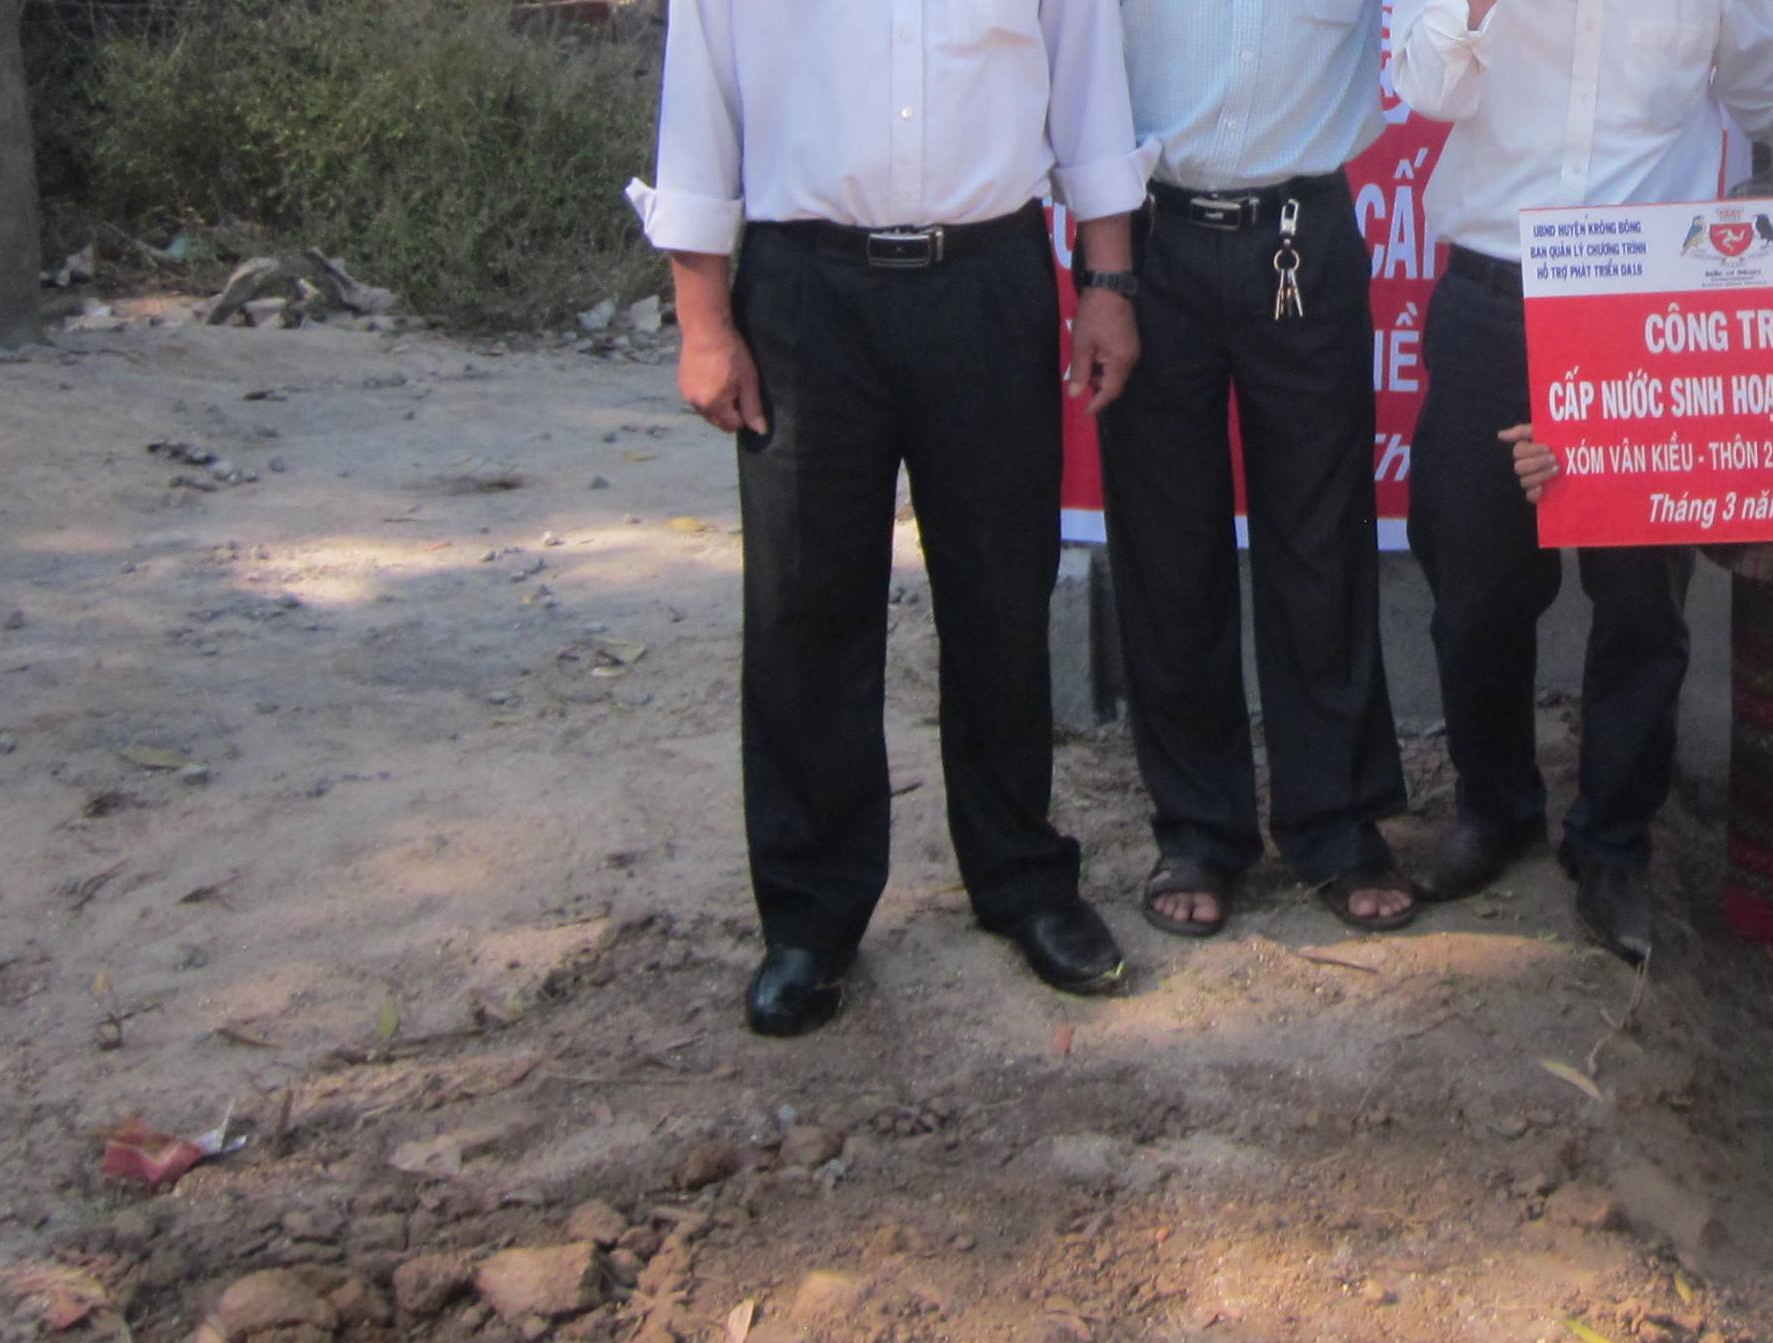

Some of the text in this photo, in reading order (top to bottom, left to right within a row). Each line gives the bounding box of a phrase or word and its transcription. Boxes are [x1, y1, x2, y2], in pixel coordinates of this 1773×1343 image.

[1533, 224, 1556, 237] UBND
[1558, 221, 1586, 238] HUYỆN
[1530, 245, 1547, 258] BAN
[1570, 263, 1590, 278] PHÁT
[1645, 302, 1728, 354] CÔNG
[1549, 365, 1594, 421] CẤP
[1601, 368, 1664, 420] NƯỚC
[1670, 376, 1725, 417] SINH
[1565, 438, 1604, 475] XÓM
[1609, 437, 1646, 473] VÂN
[1652, 431, 1693, 472] KIỀU
[1708, 433, 1758, 470] THÔN
[1763, 441, 1773, 469] 2
[1650, 491, 1717, 529] Tháng
[1722, 491, 1736, 520] 3
